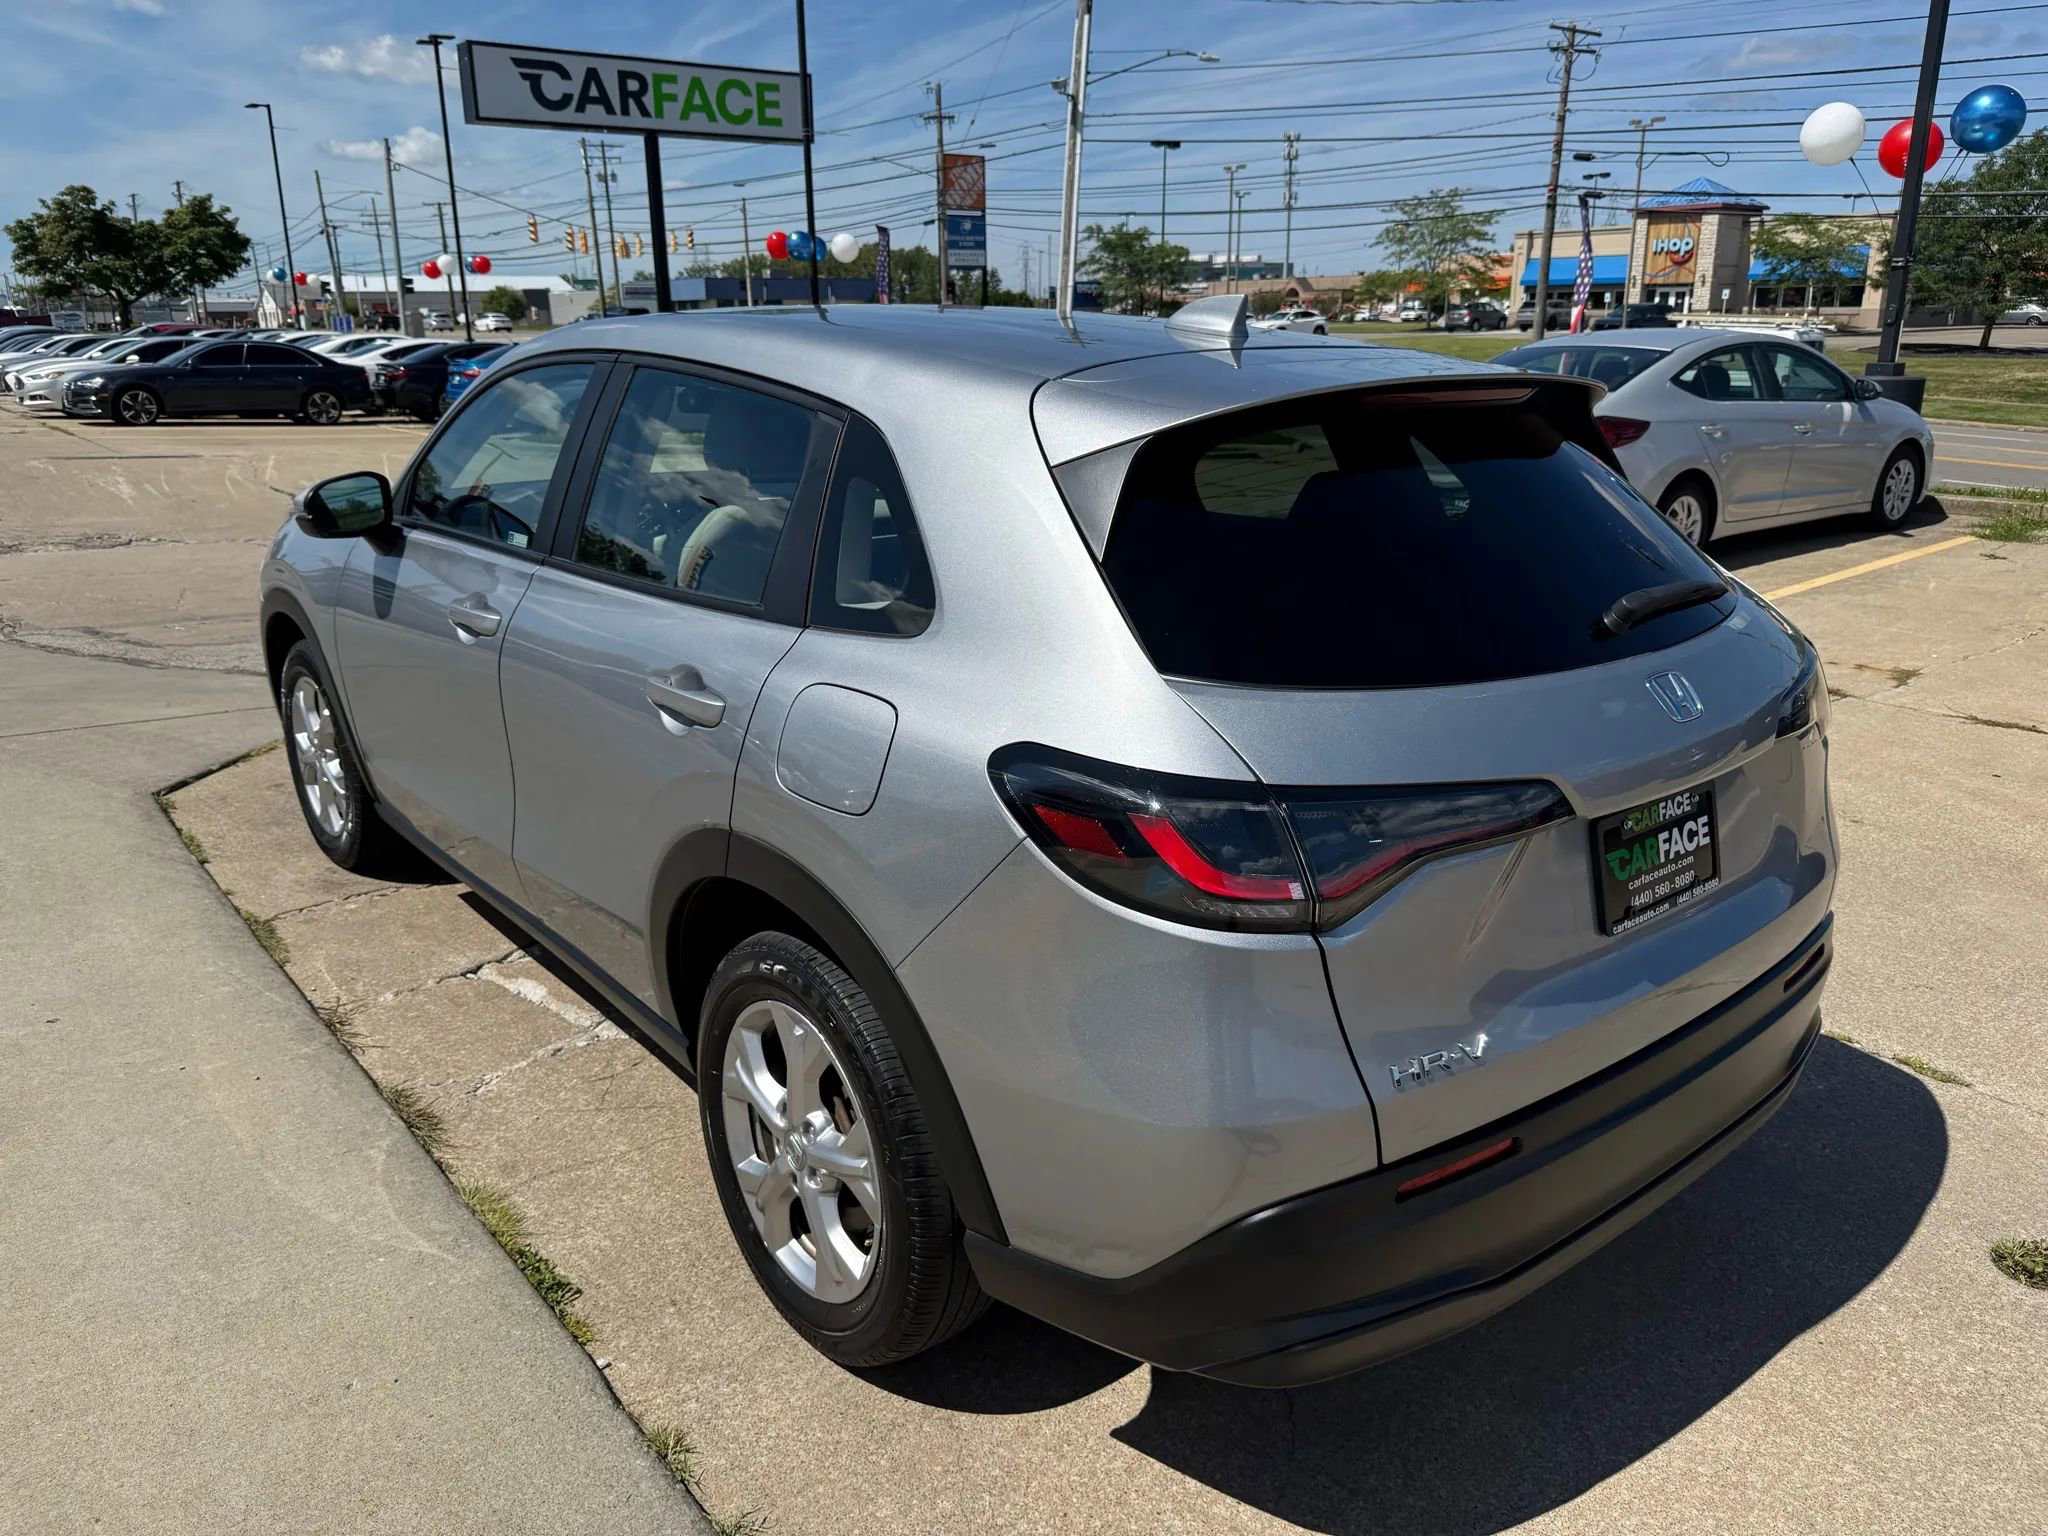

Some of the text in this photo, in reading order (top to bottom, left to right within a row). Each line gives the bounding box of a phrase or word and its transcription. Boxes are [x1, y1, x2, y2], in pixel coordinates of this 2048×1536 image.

[509, 57, 783, 128] CARFACE
[1652, 236, 1695, 257] IHOP
[1626, 792, 1692, 832] CARFACE
[1605, 815, 1711, 880] CARFACE
[1628, 855, 1694, 890] carfaceauto.com
[1612, 902, 1669, 934] carfaceauto.com
[1676, 890, 1692, 906] (440)
[1631, 889, 1652, 907] (440)
[1390, 1033, 1489, 1089] HR-V
